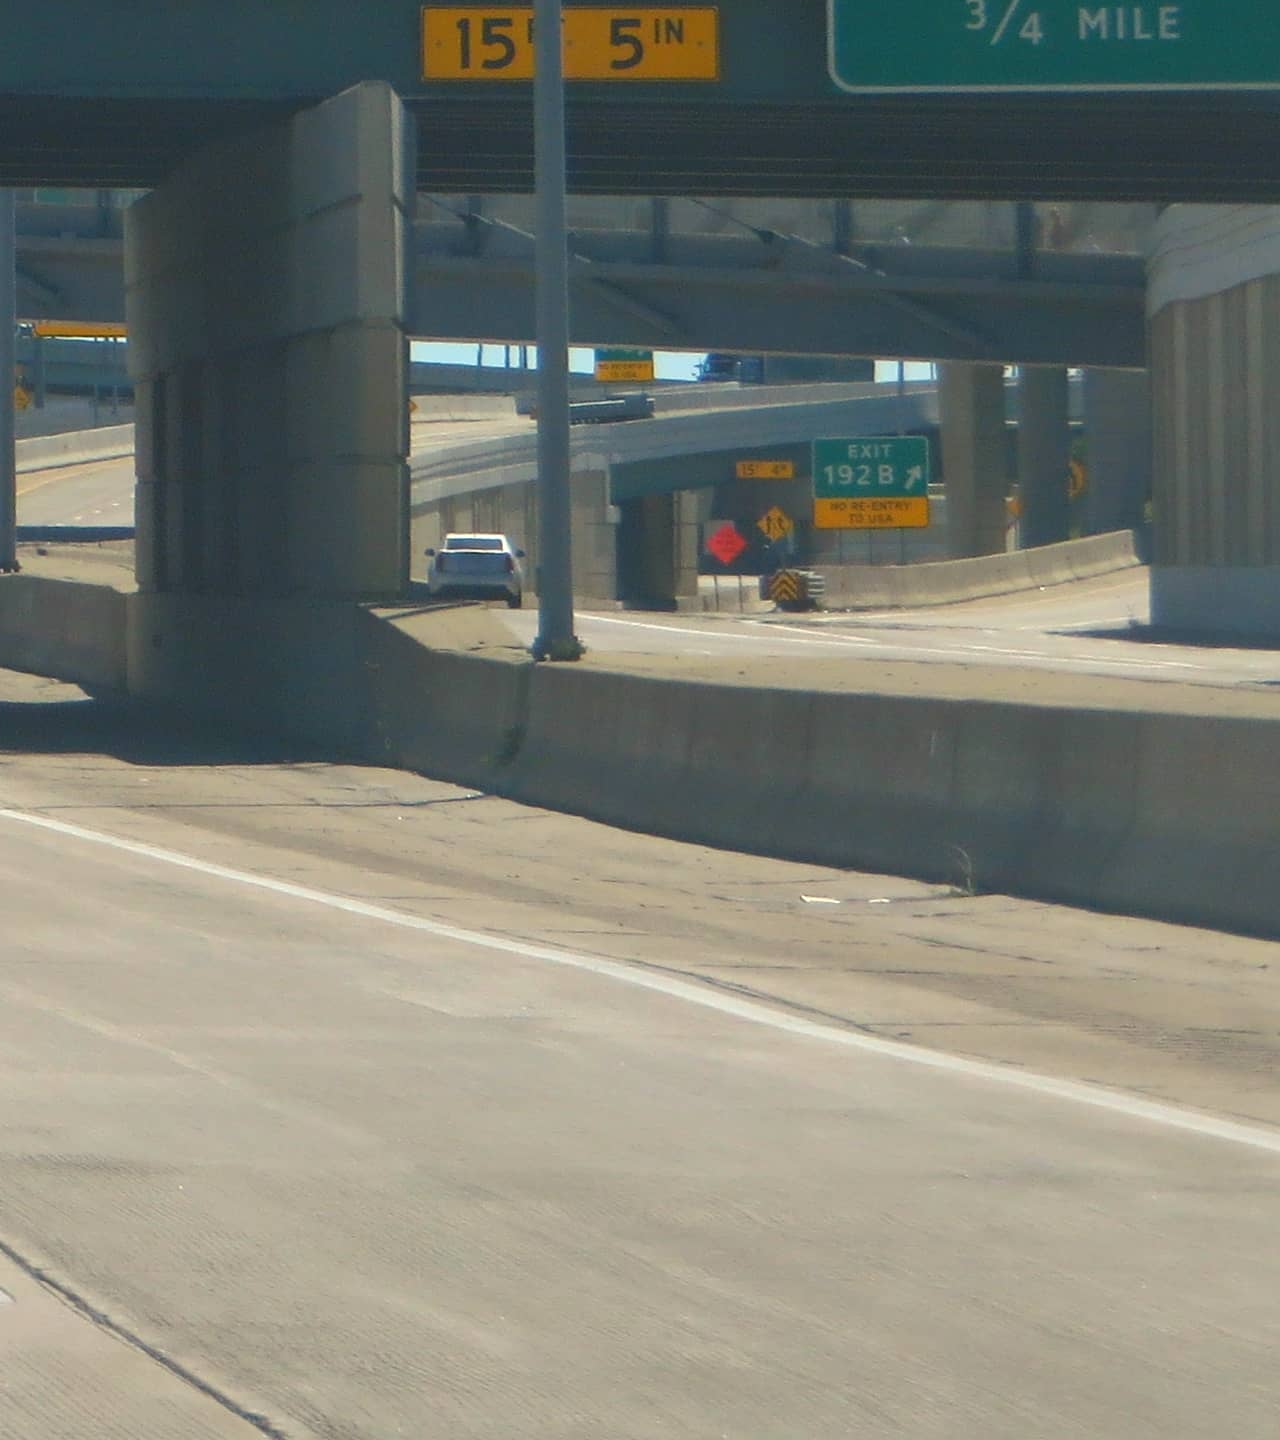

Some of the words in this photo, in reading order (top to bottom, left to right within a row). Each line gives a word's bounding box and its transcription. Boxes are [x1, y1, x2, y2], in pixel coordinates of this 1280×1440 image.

[1077, 5, 1182, 41] MILE
[456, 17, 517, 71] 15
[848, 444, 895, 459] EXIT
[824, 464, 871, 485] 192
[878, 464, 894, 485] B
[830, 502, 847, 512] NO
[851, 501, 910, 512] RE-ENTRY
[849, 513, 864, 523] TO
[871, 513, 894, 523] USA
